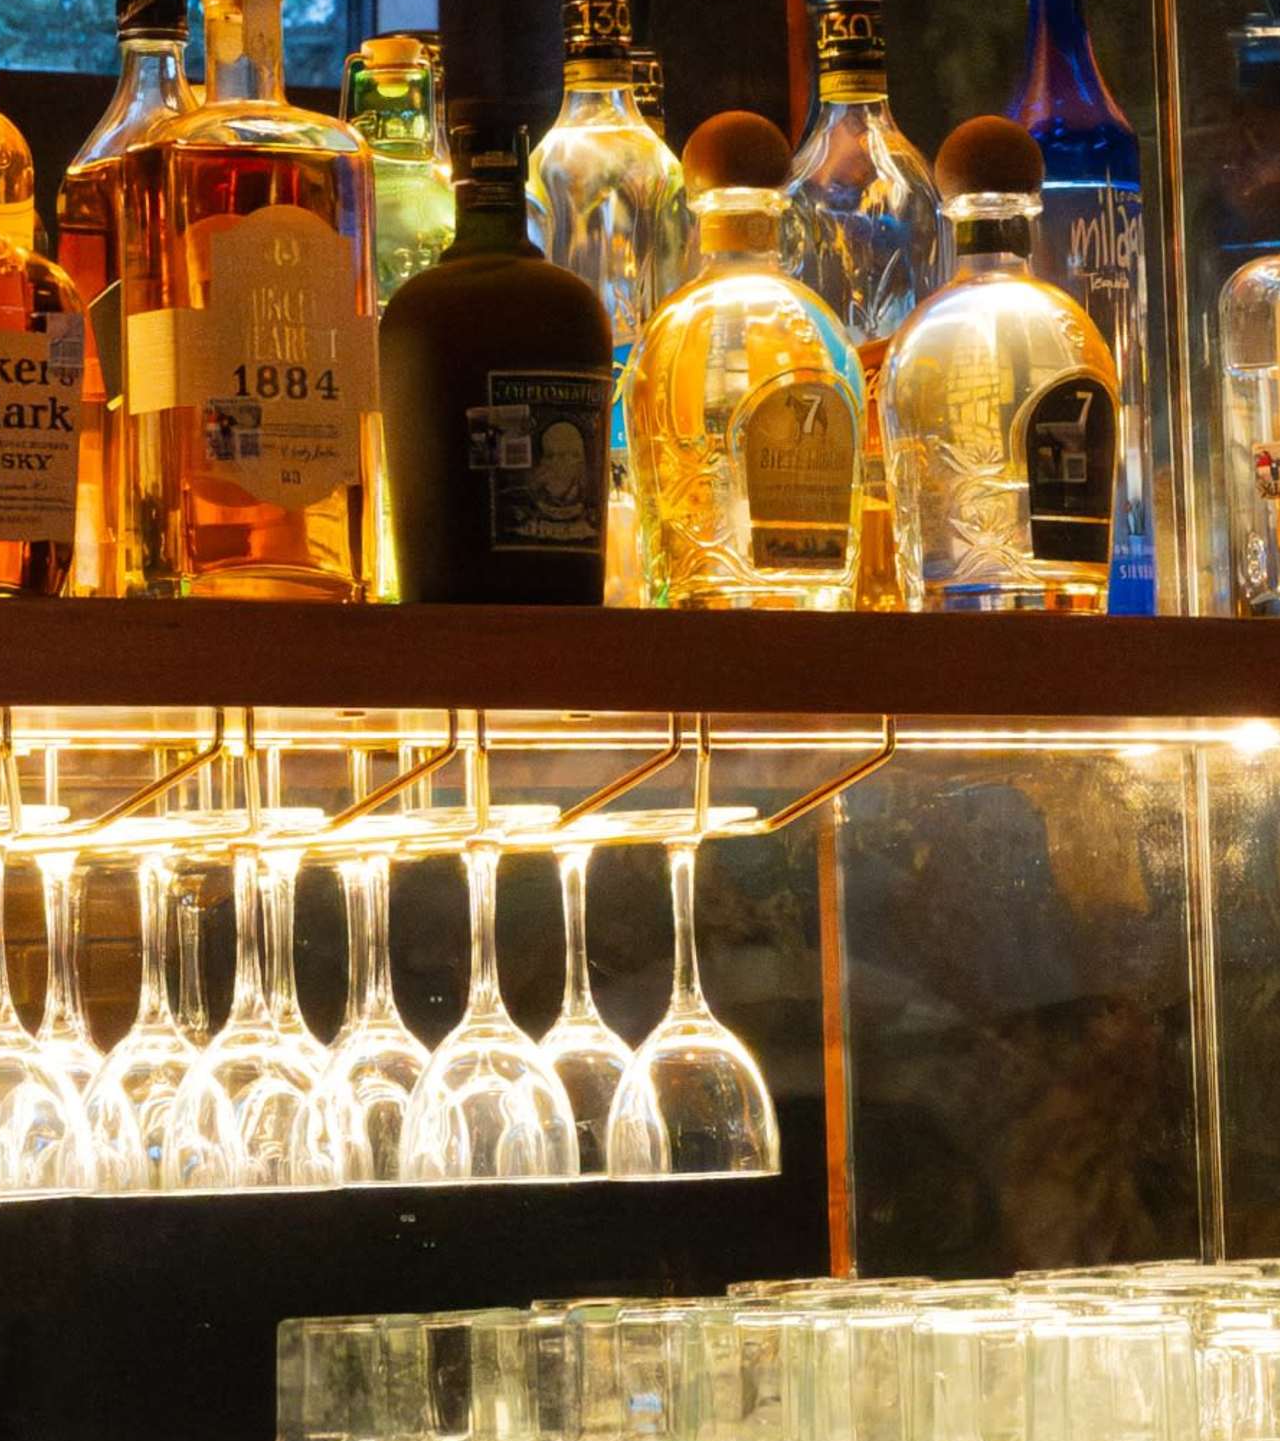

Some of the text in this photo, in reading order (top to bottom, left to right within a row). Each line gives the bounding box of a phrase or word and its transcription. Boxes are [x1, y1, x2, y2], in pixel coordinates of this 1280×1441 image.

[234, 363, 340, 401] 1884
[803, 393, 821, 434] 7
[1075, 391, 1094, 432] 7
